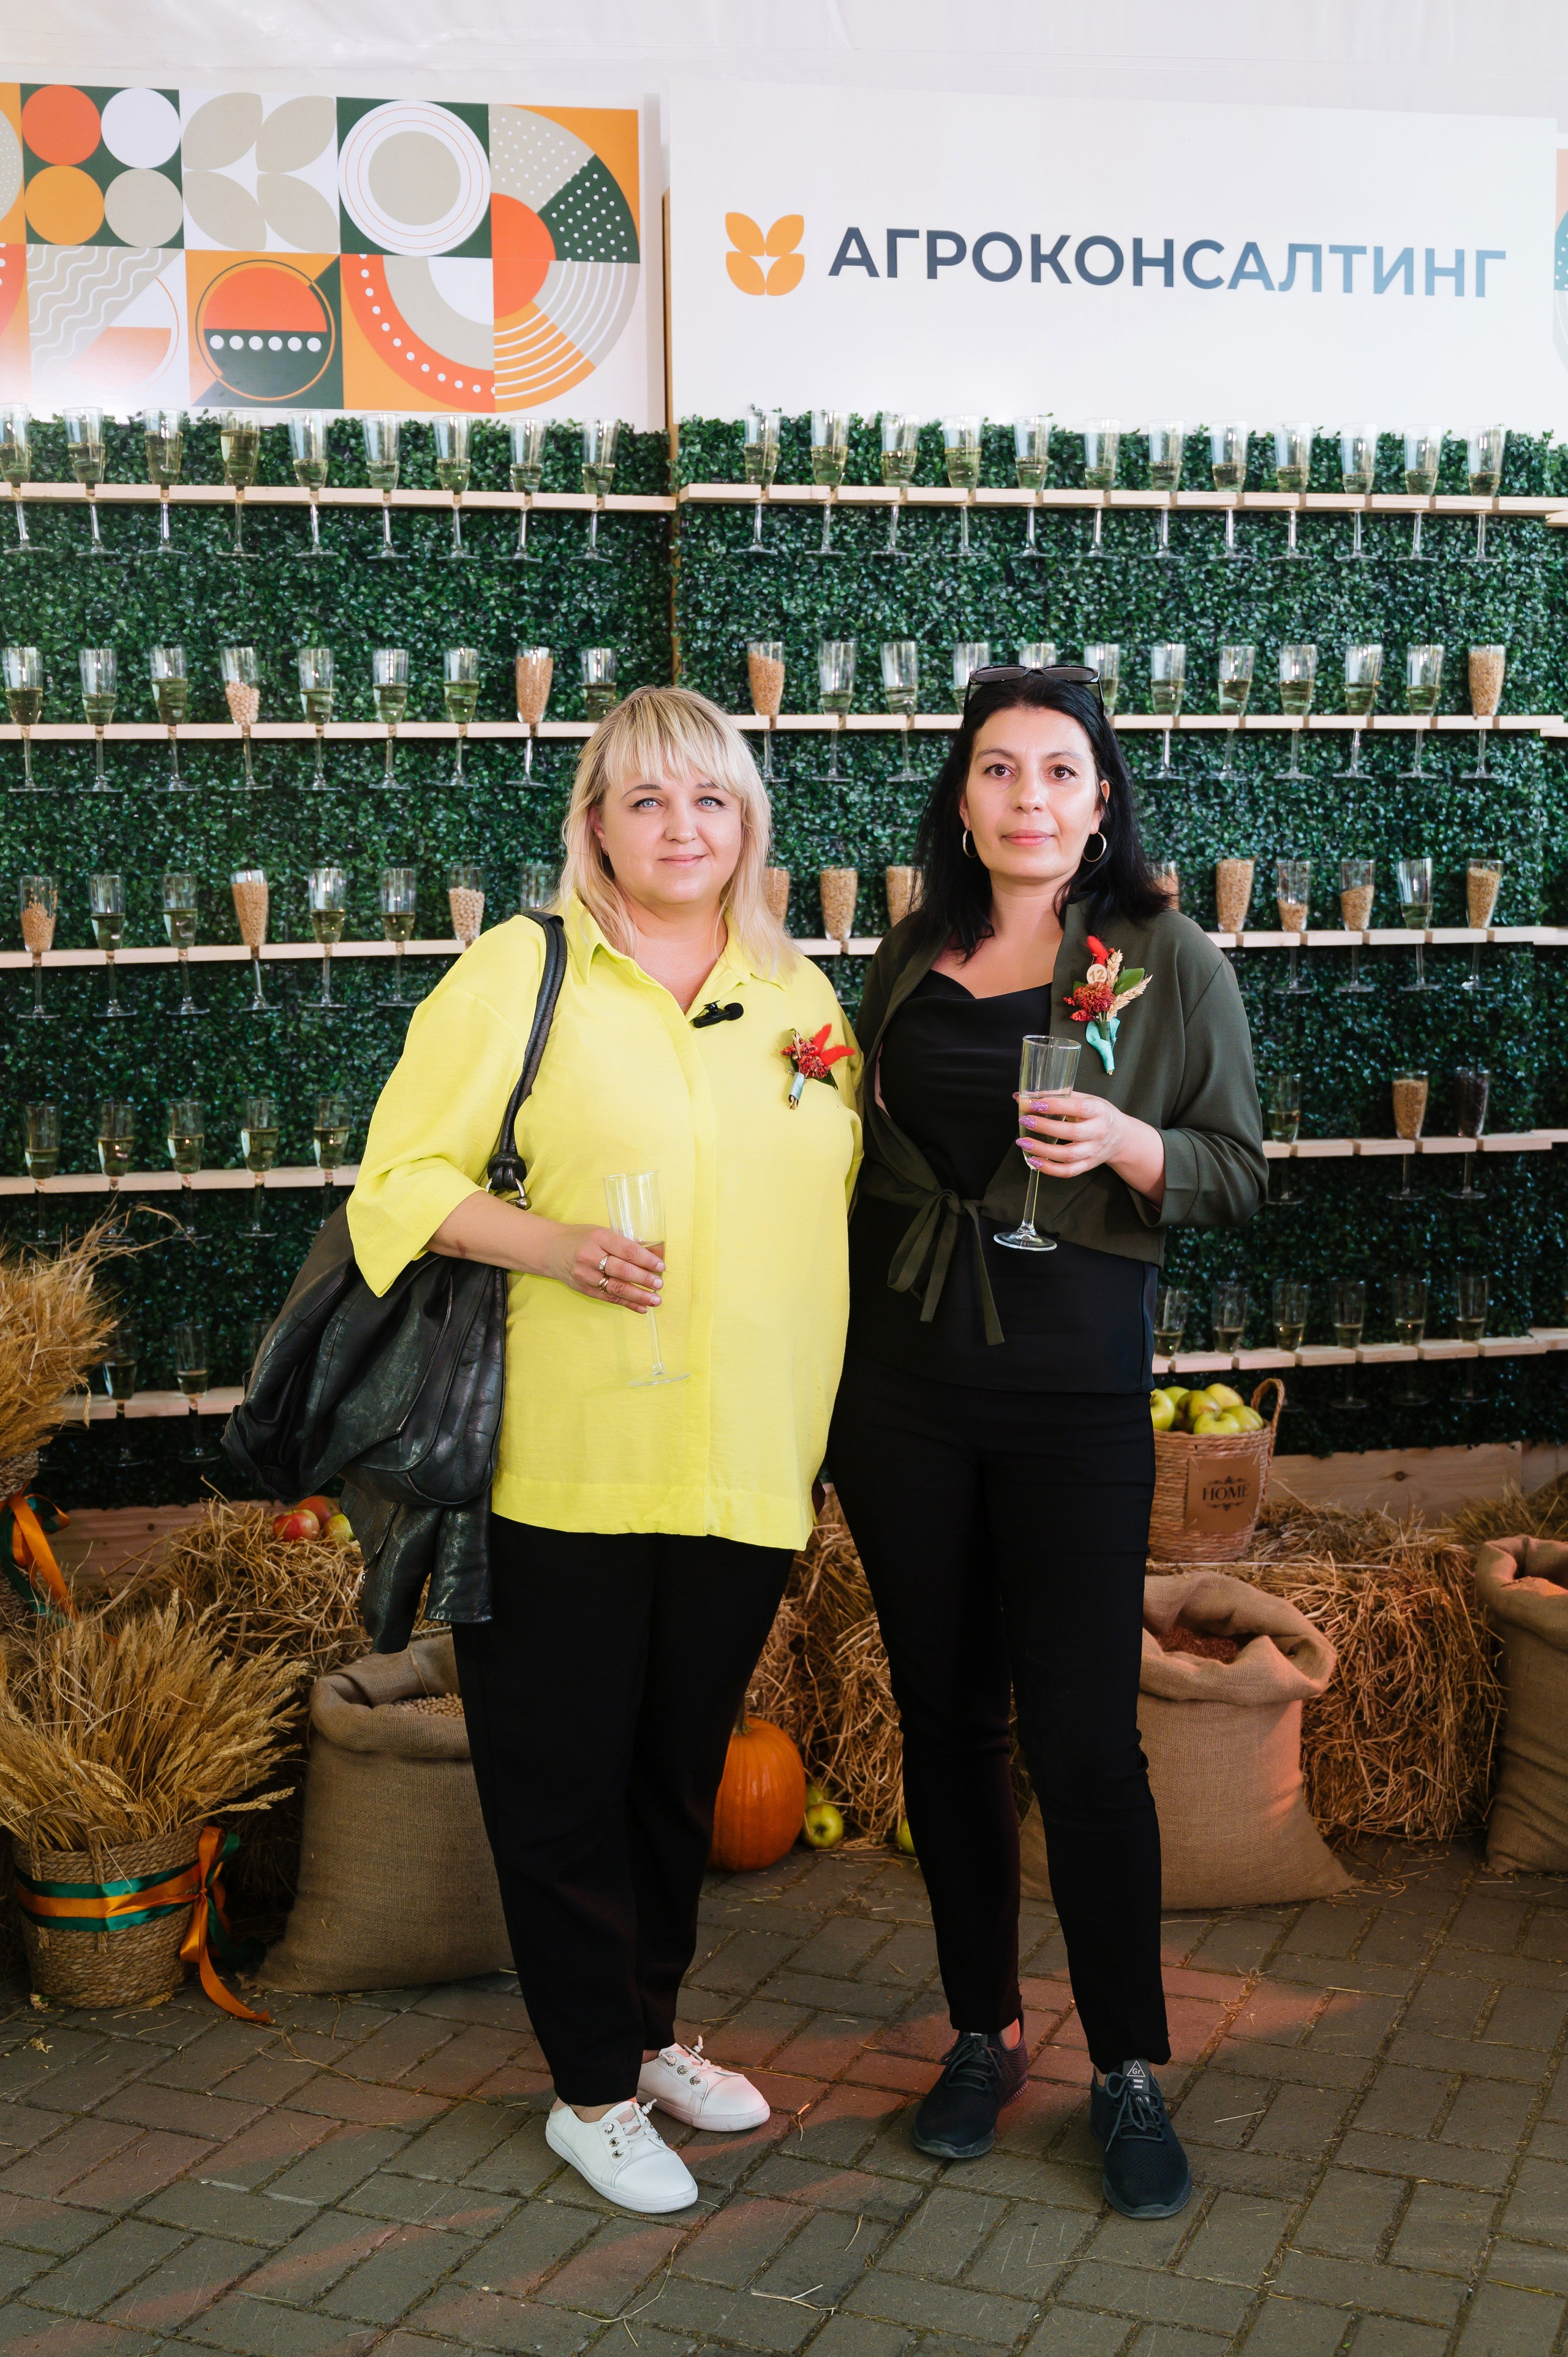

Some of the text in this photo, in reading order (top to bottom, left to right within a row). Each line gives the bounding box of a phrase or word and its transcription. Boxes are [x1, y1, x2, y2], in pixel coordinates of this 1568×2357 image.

[828, 227, 1506, 298] АГРОКОНСАЛТИНГ
[1090, 969, 1105, 981] 12
[1202, 1484, 1249, 1500] HOME
